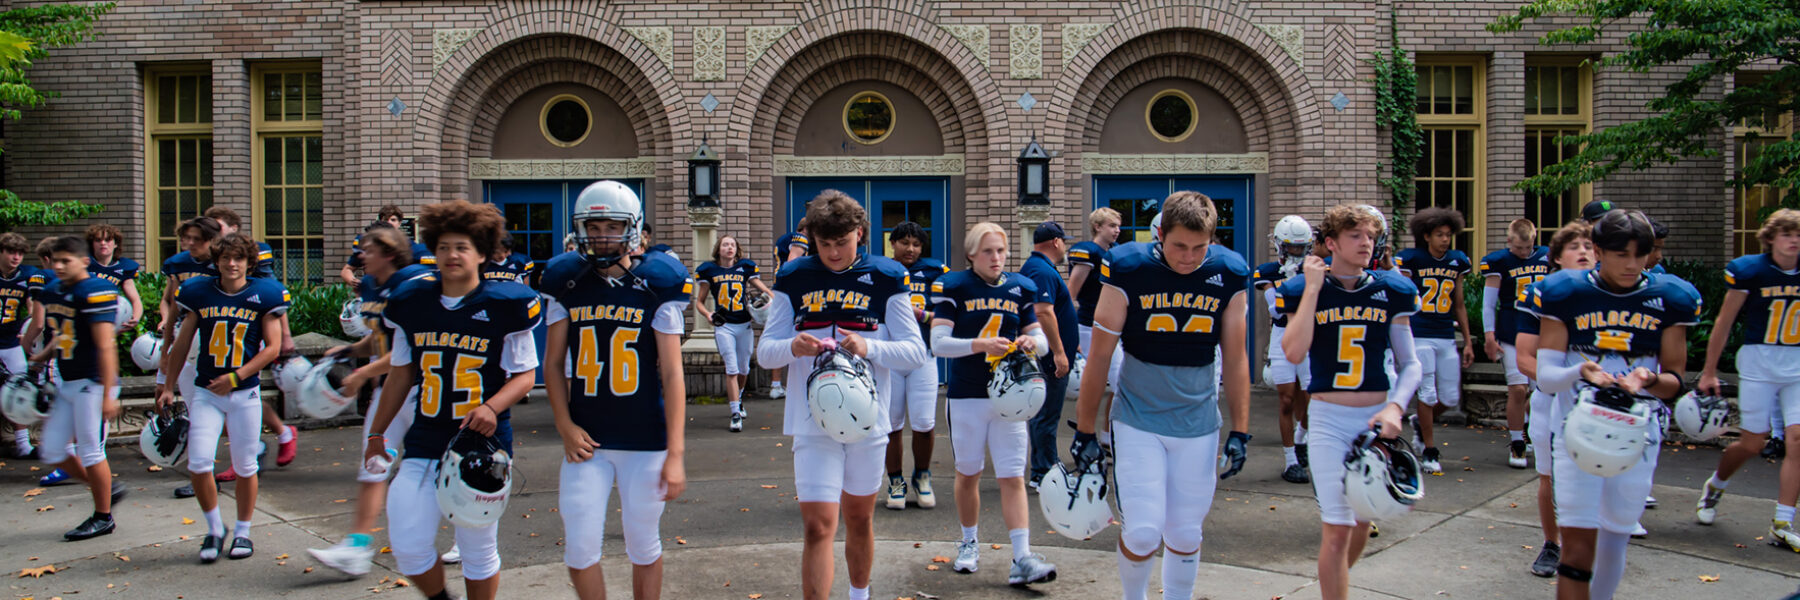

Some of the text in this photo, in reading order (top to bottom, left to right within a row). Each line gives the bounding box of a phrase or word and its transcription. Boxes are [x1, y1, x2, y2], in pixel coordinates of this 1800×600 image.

[713, 273, 744, 283] WILDCATS
[1418, 267, 1458, 279] WILDCATS
[718, 282, 743, 311] 42
[801, 288, 871, 308] WILDCATS
[1139, 292, 1221, 312] WILDCATS
[1421, 278, 1455, 313] 28
[199, 306, 258, 321] WILDCATS
[569, 304, 644, 324] WILDCATS
[1315, 306, 1387, 325] WILDCATS
[1574, 310, 1661, 330] WILDCATS
[1763, 299, 1800, 345] 10
[208, 320, 249, 368] 41
[413, 332, 490, 352] WILDCATS
[575, 325, 642, 397] 46
[1332, 324, 1367, 389] 5
[420, 351, 487, 420] 65
